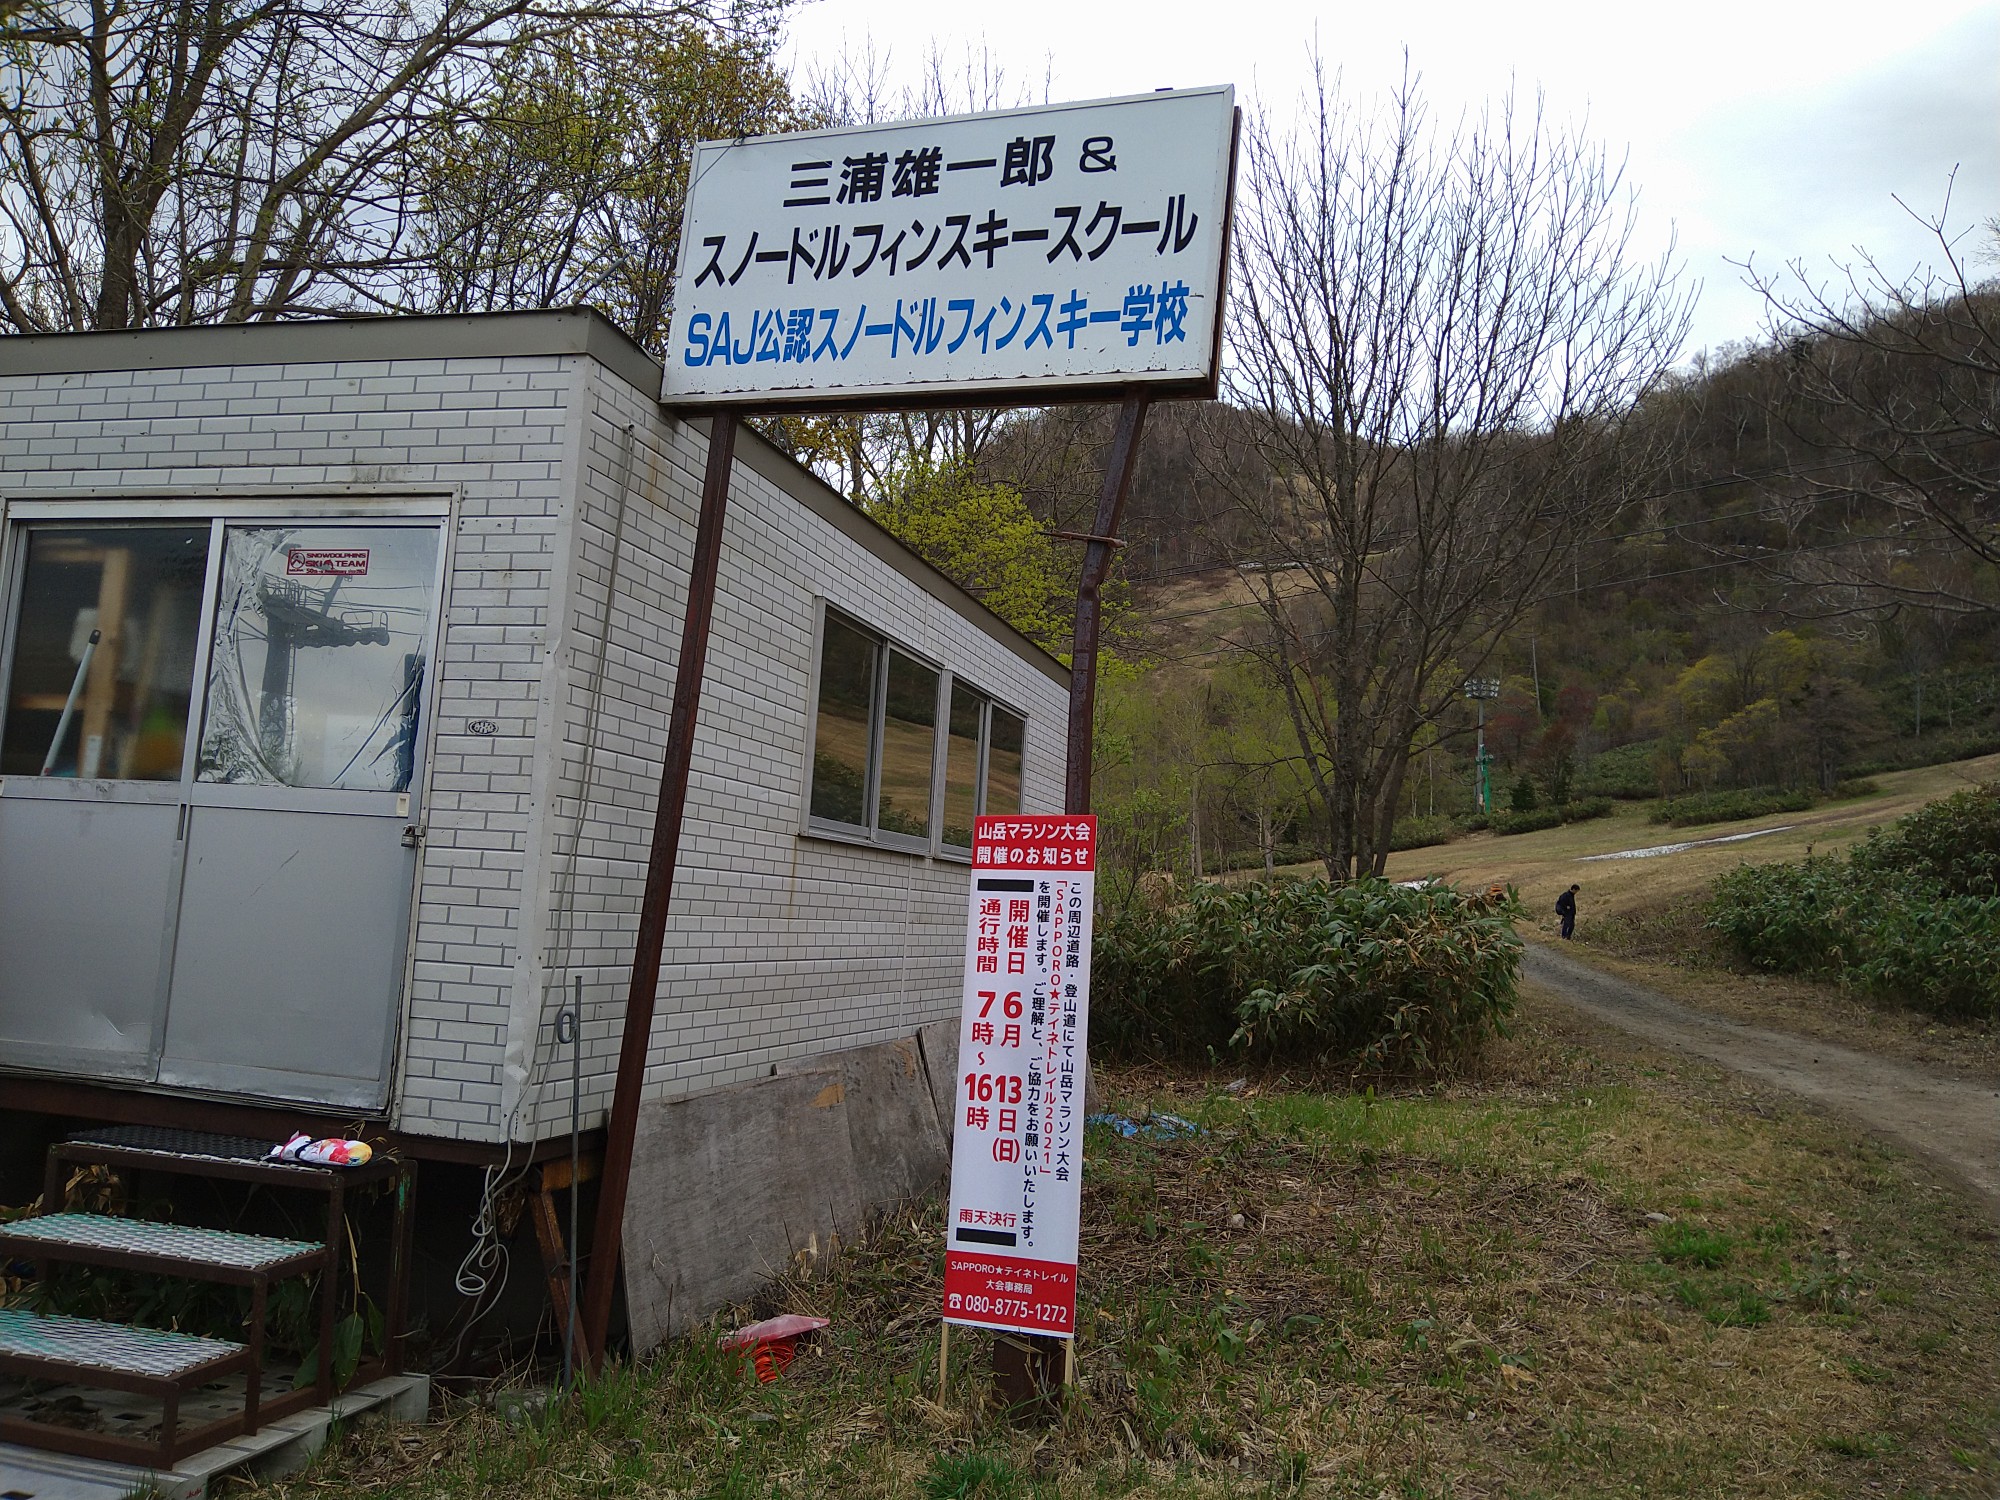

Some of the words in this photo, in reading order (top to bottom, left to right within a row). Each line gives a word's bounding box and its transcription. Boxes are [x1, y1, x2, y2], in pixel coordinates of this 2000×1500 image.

[783, 136, 1056, 209] 三浦雄一郎
[1079, 136, 1118, 174] &
[694, 194, 1199, 288] スノードルフィンスキースクール
[684, 280, 1191, 367] SAJ公認スノードルフィンスキー学校
[978, 822, 1090, 842] 山岳マラソン大会
[976, 847, 1089, 866] 開催のお知らせ
[959, 1208, 1017, 1228] 雨天決行
[985, 1279, 1033, 1295] 大会事務局
[965, 1294, 1067, 1324] 080-8775-1272
